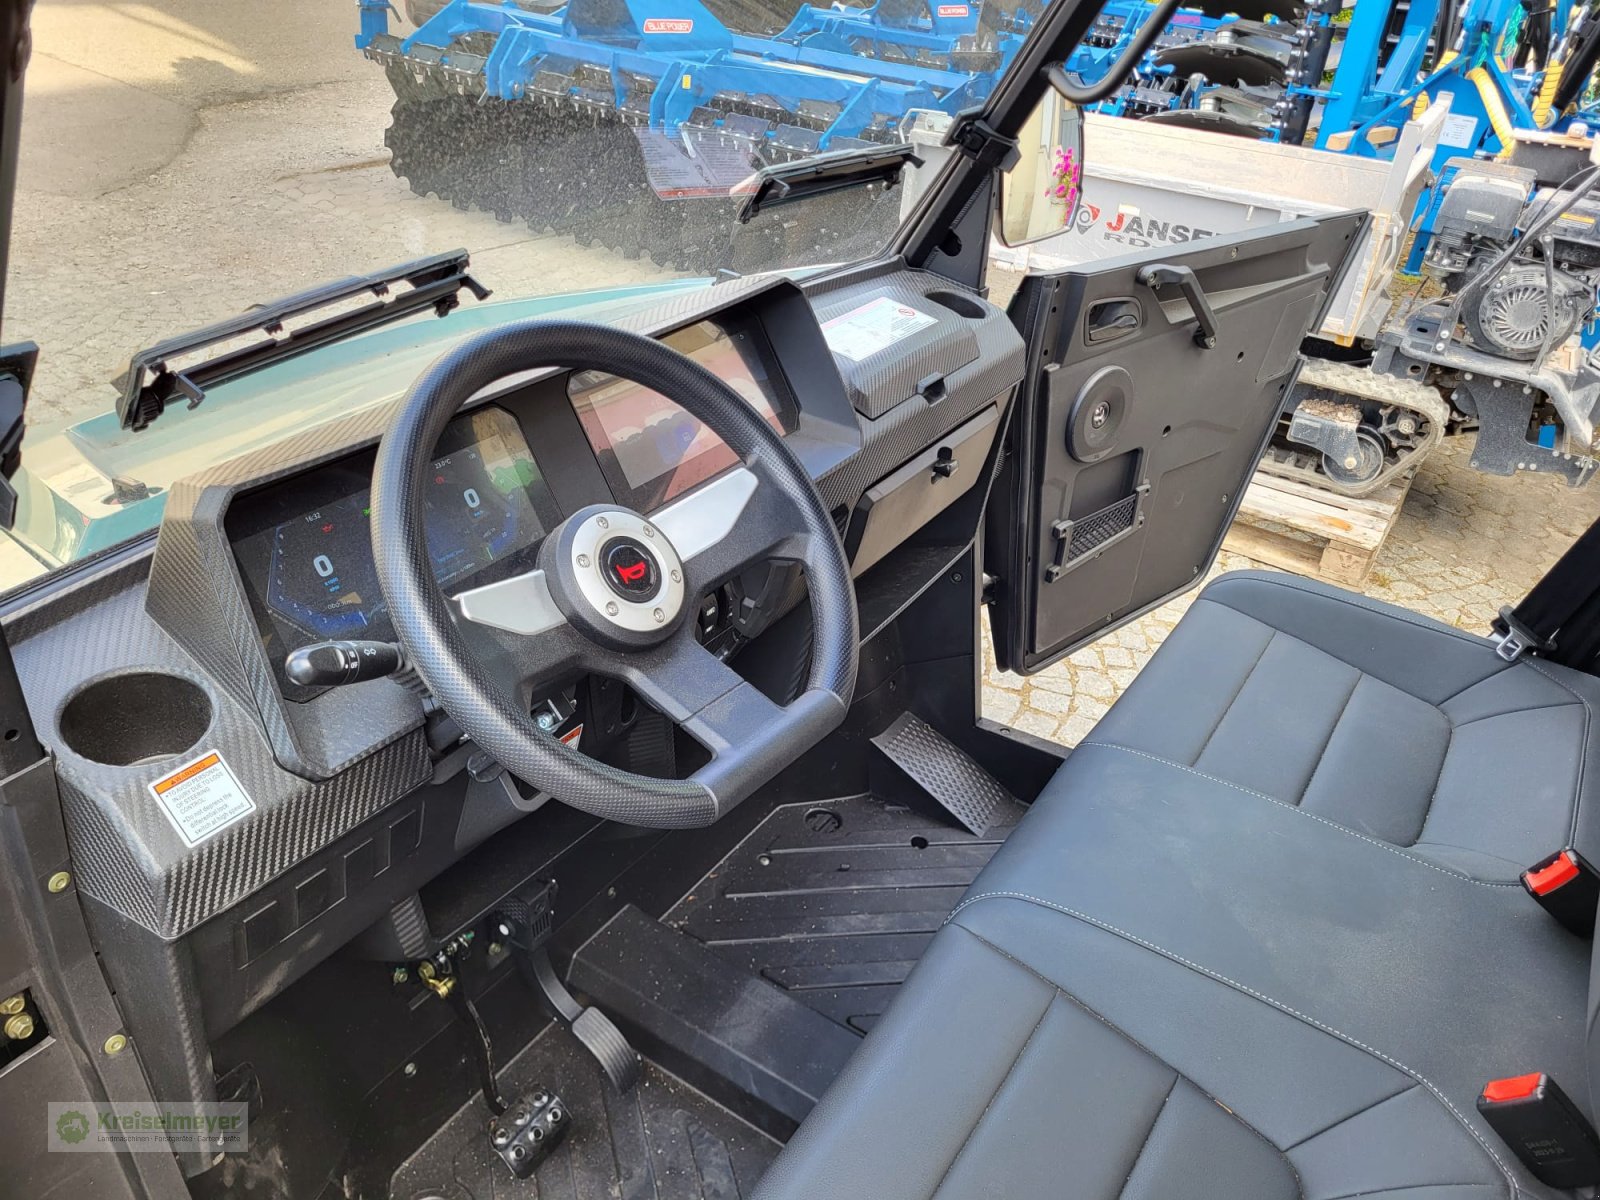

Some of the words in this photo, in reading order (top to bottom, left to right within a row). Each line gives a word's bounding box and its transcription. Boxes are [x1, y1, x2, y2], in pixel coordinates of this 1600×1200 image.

[647, 22, 667, 31] BLUE
[667, 22, 690, 31] POWER
[1106, 213, 1222, 244] JANSE
[463, 488, 480, 508] 0
[305, 512, 322, 523] 16:32
[313, 554, 334, 577] 0
[175, 763, 205, 781] WARNING
[190, 783, 202, 791] DUE
[209, 771, 223, 781] LOSS
[191, 766, 219, 783] PERSONAL
[183, 786, 210, 803] STEERING
[193, 808, 203, 816] not
[202, 797, 223, 812] depress
[193, 821, 211, 834] switch
[215, 811, 229, 822] high
